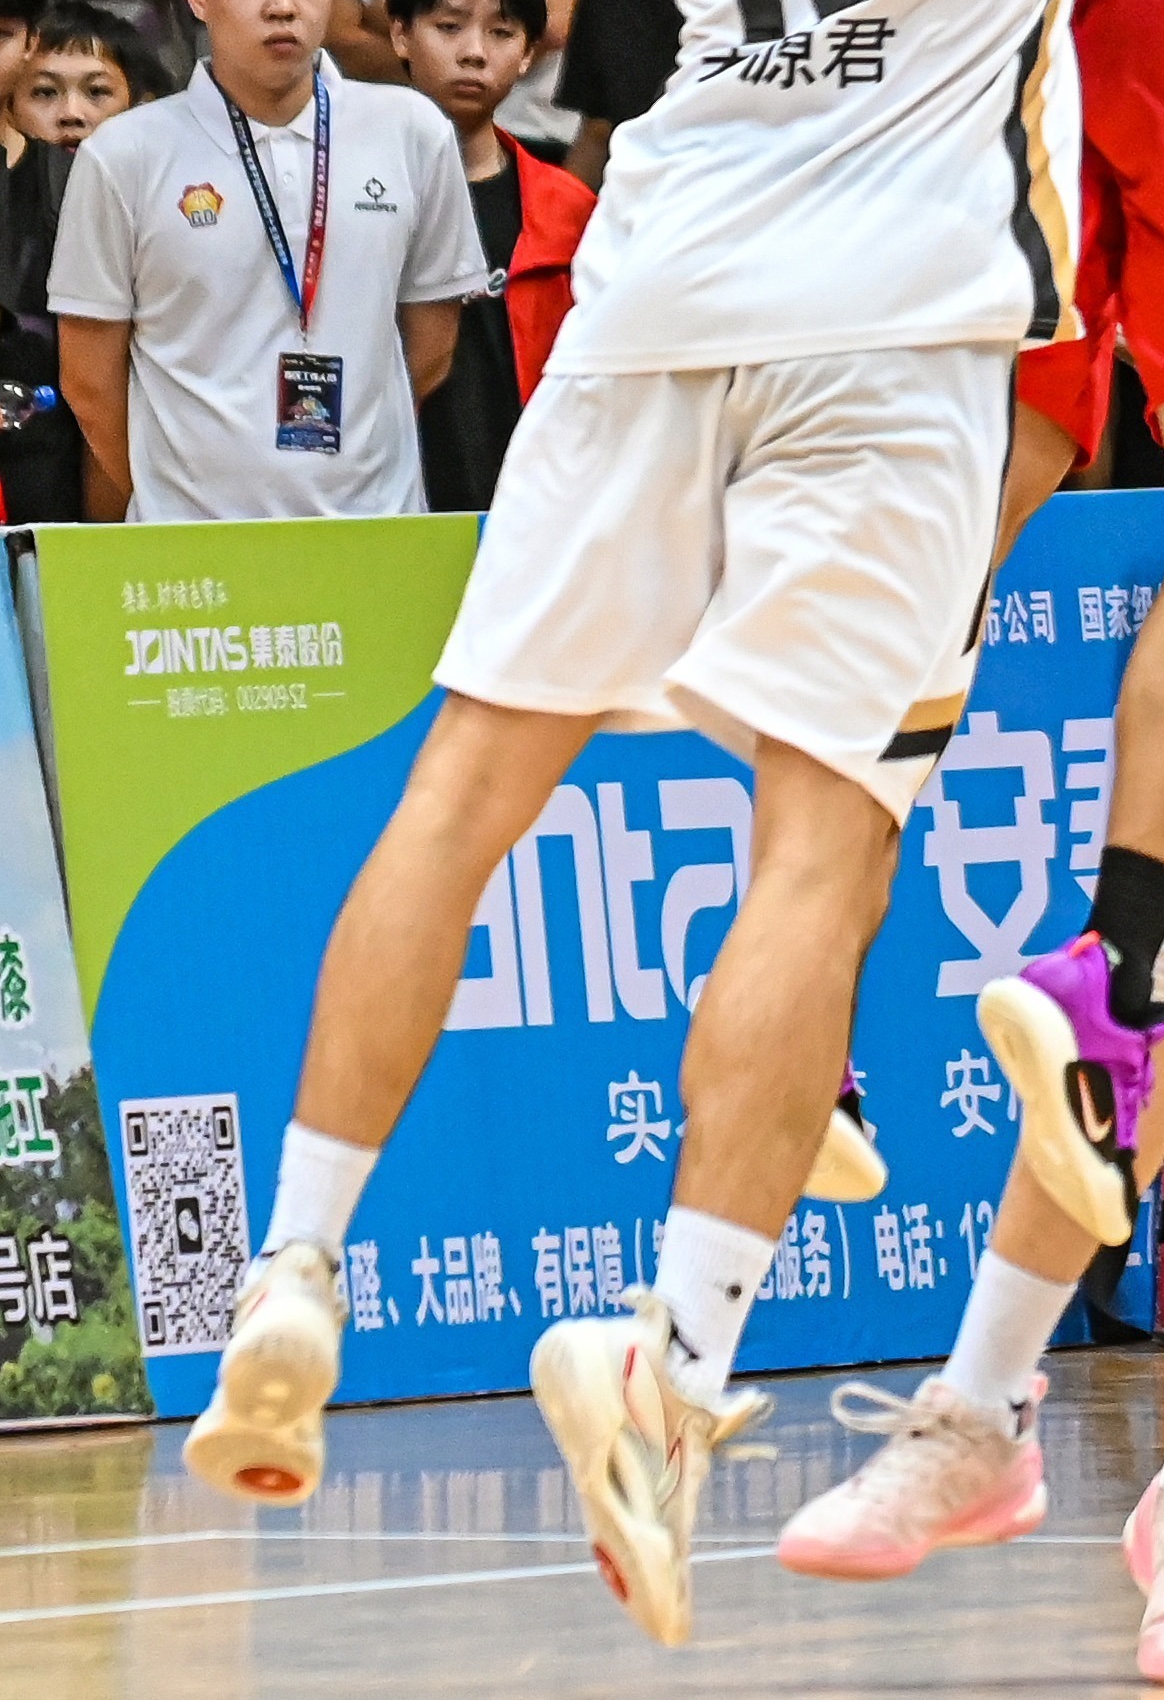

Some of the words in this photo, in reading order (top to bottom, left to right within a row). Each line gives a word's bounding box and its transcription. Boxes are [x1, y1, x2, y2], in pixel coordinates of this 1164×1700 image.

[125, 626, 248, 676] JOINTAS
[249, 622, 344, 669] 集泰股份
